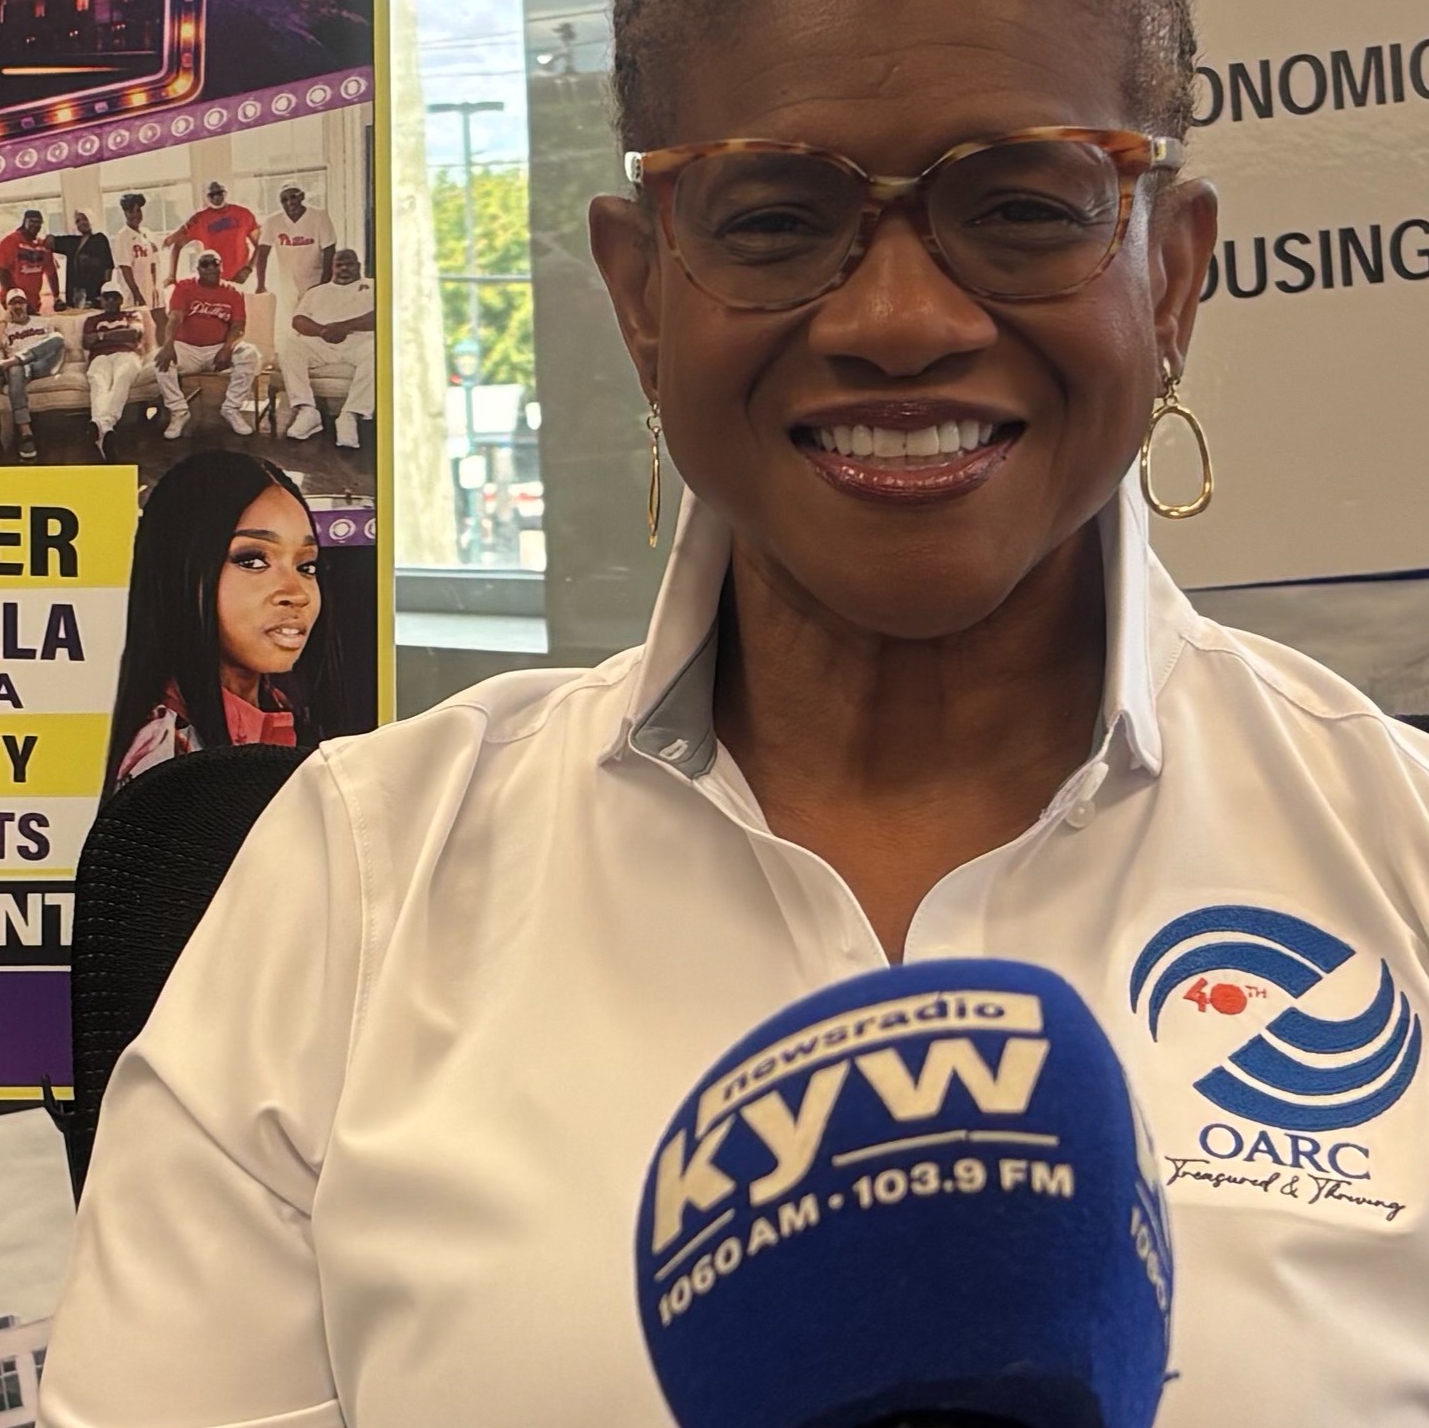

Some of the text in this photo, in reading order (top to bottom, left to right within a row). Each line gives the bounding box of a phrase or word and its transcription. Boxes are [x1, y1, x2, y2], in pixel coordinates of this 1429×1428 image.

[722, 997, 1005, 1102] newsradio
[1165, 1156, 1281, 1192] Treasured
[1280, 1175, 1299, 1199] &
[1199, 1123, 1371, 1180] OARC
[659, 1158, 1072, 1327] 1060 AM 103.9 FM
